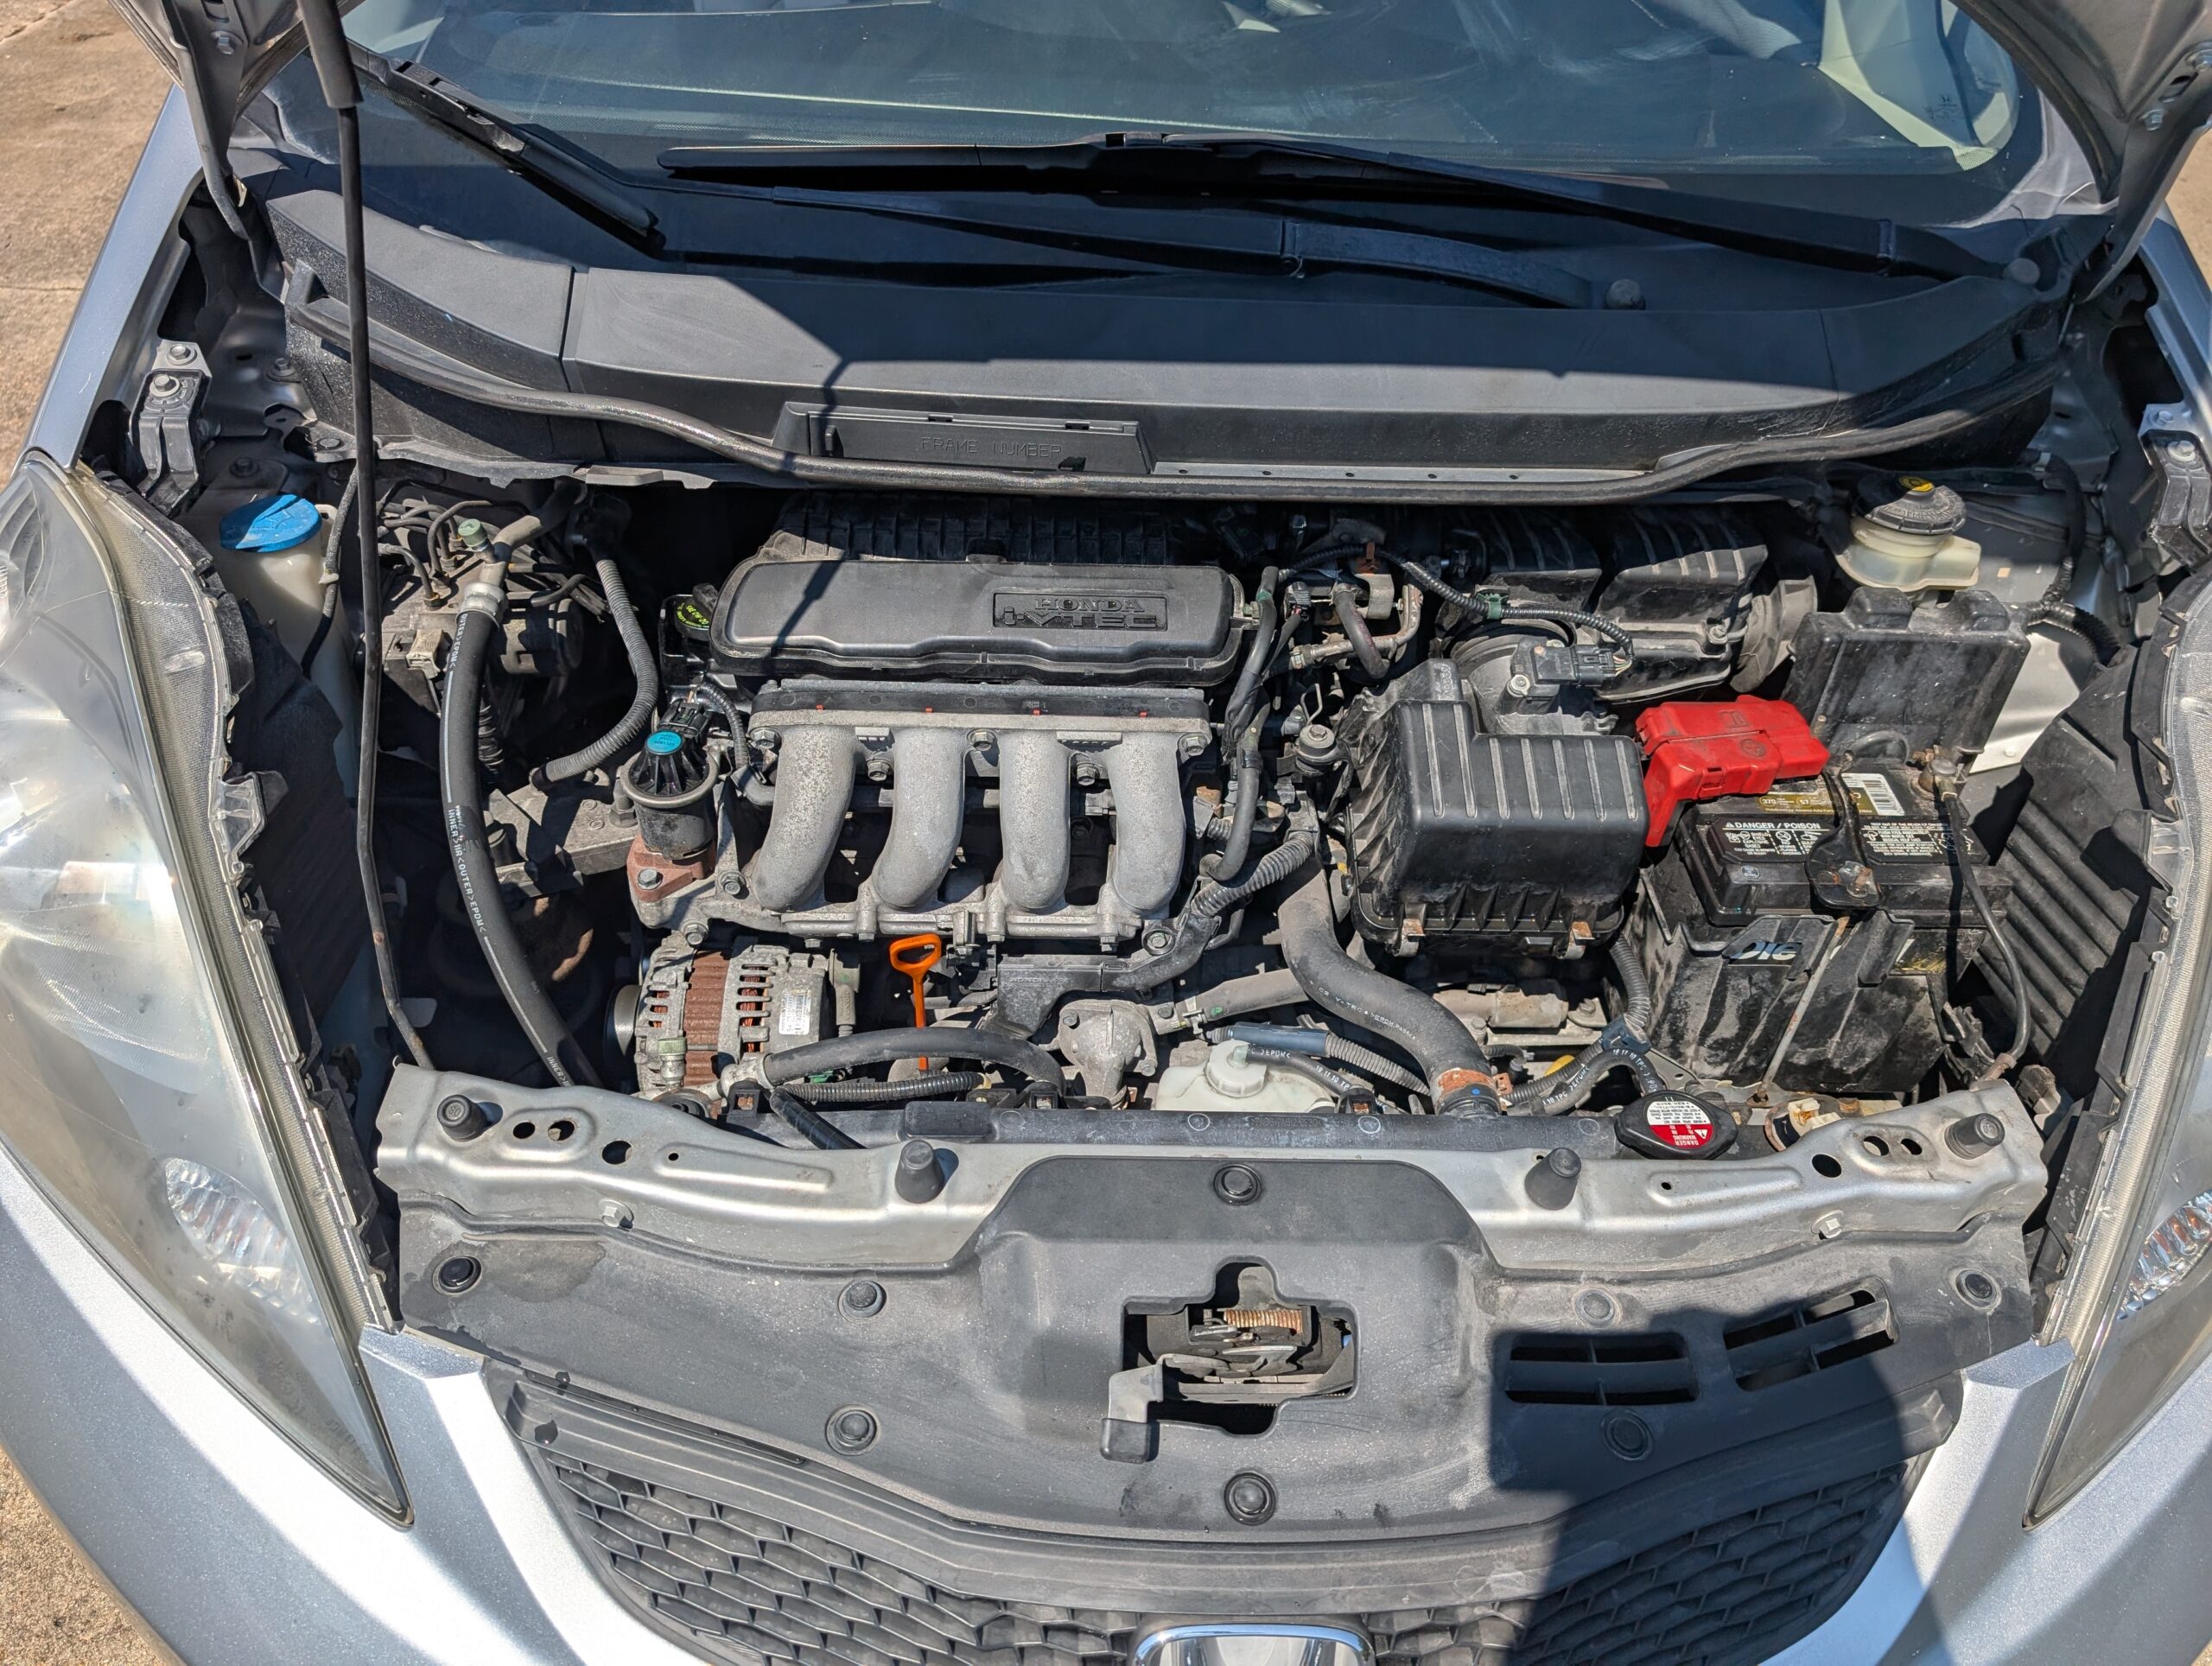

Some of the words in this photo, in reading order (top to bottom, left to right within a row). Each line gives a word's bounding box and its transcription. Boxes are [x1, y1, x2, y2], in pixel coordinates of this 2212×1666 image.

[921, 436, 979, 453] FRAME
[994, 442, 1062, 458] NUMBER
[1035, 598, 1145, 612] HONDA
